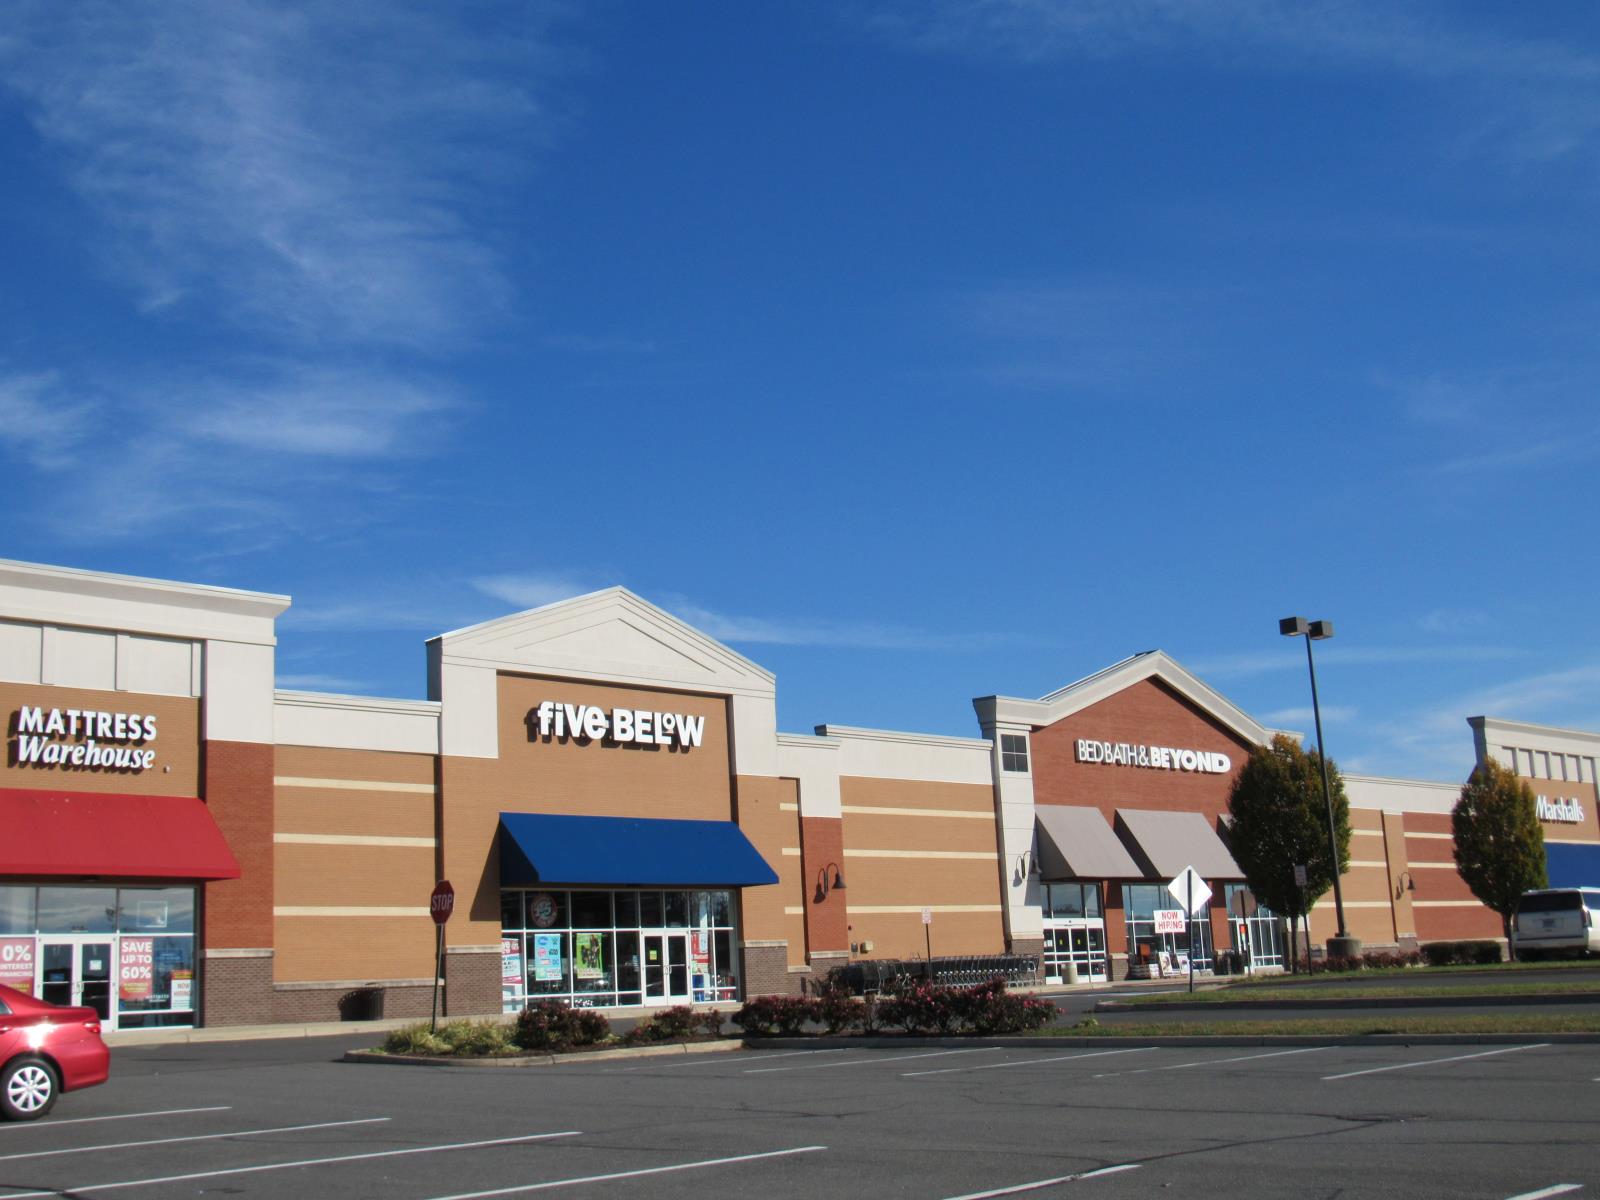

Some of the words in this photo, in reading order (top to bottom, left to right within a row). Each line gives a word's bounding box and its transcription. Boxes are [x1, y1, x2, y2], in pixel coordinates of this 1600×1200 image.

[18, 705, 157, 741] MATTRESS
[537, 701, 609, 740] five
[613, 708, 705, 747] BELOW
[18, 734, 156, 769] Warehouse
[1078, 739, 1104, 762] BED
[1104, 742, 1137, 765] BATH
[1138, 745, 1150, 767] &
[1150, 746, 1231, 773] BEYOND
[1535, 794, 1585, 822] Marshalls
[432, 894, 453, 911] STOP
[1161, 911, 1178, 920] NOW
[1158, 920, 1183, 930] HIRING
[2, 944, 32, 961] 0%
[121, 941, 153, 953] SAVE
[121, 954, 136, 964] UP
[137, 954, 153, 964] TO
[121, 966, 152, 979] 60%
